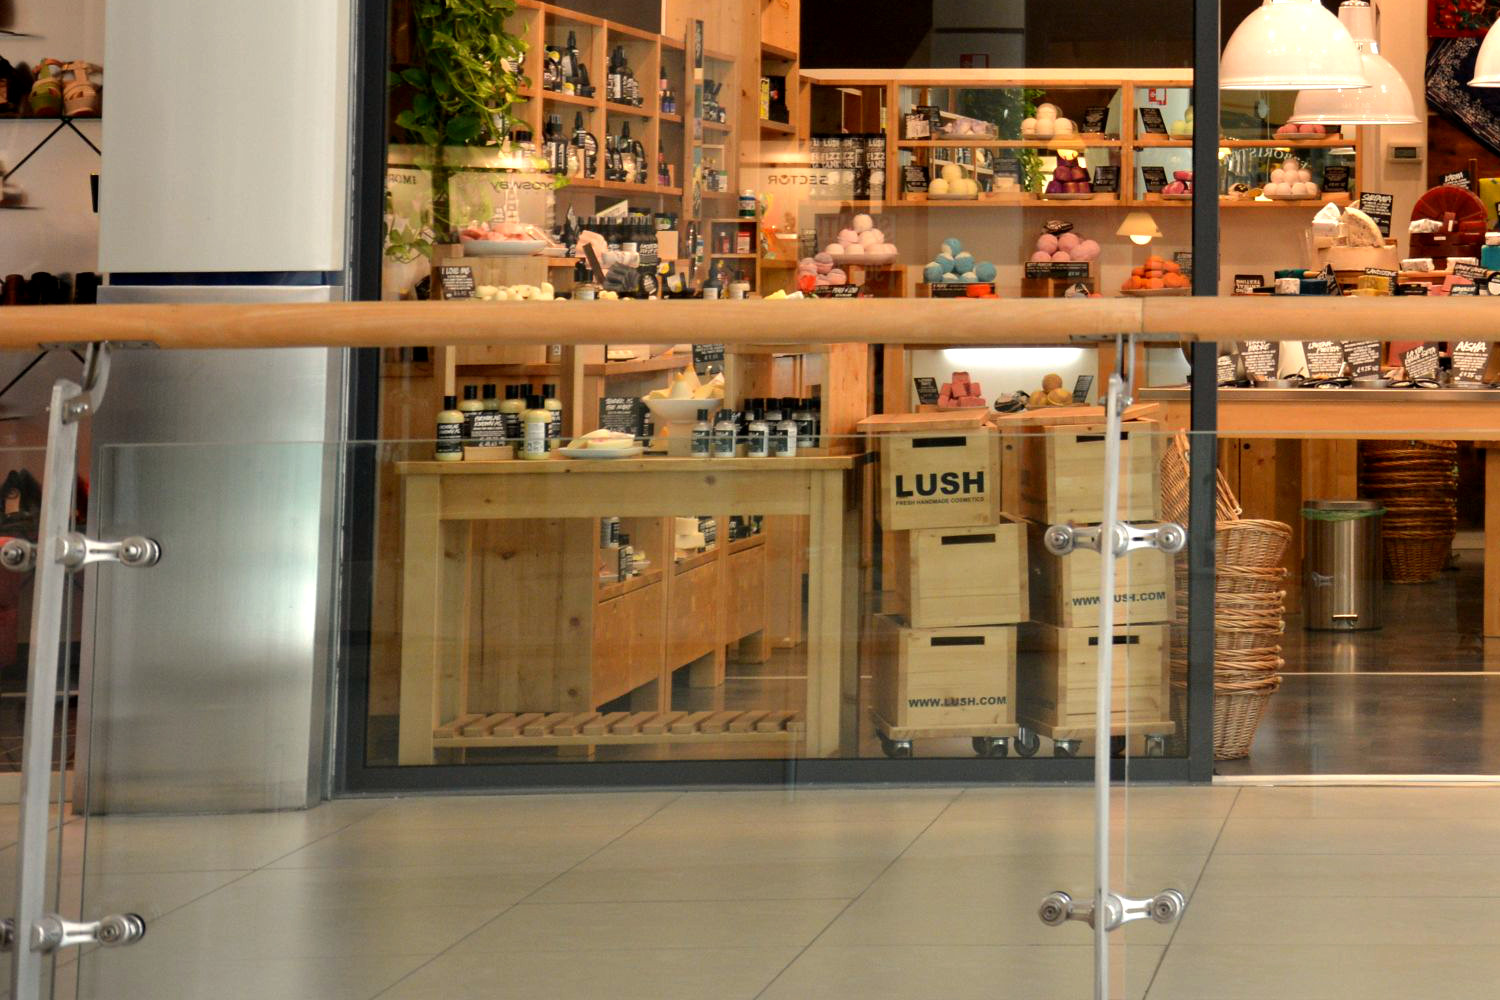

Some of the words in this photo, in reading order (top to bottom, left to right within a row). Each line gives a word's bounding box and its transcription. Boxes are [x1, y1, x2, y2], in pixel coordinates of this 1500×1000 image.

[895, 471, 985, 498] LUSH
[1072, 591, 1166, 606] WWWUSH.COM
[908, 695, 1008, 709] WWW.LUSH.COM
